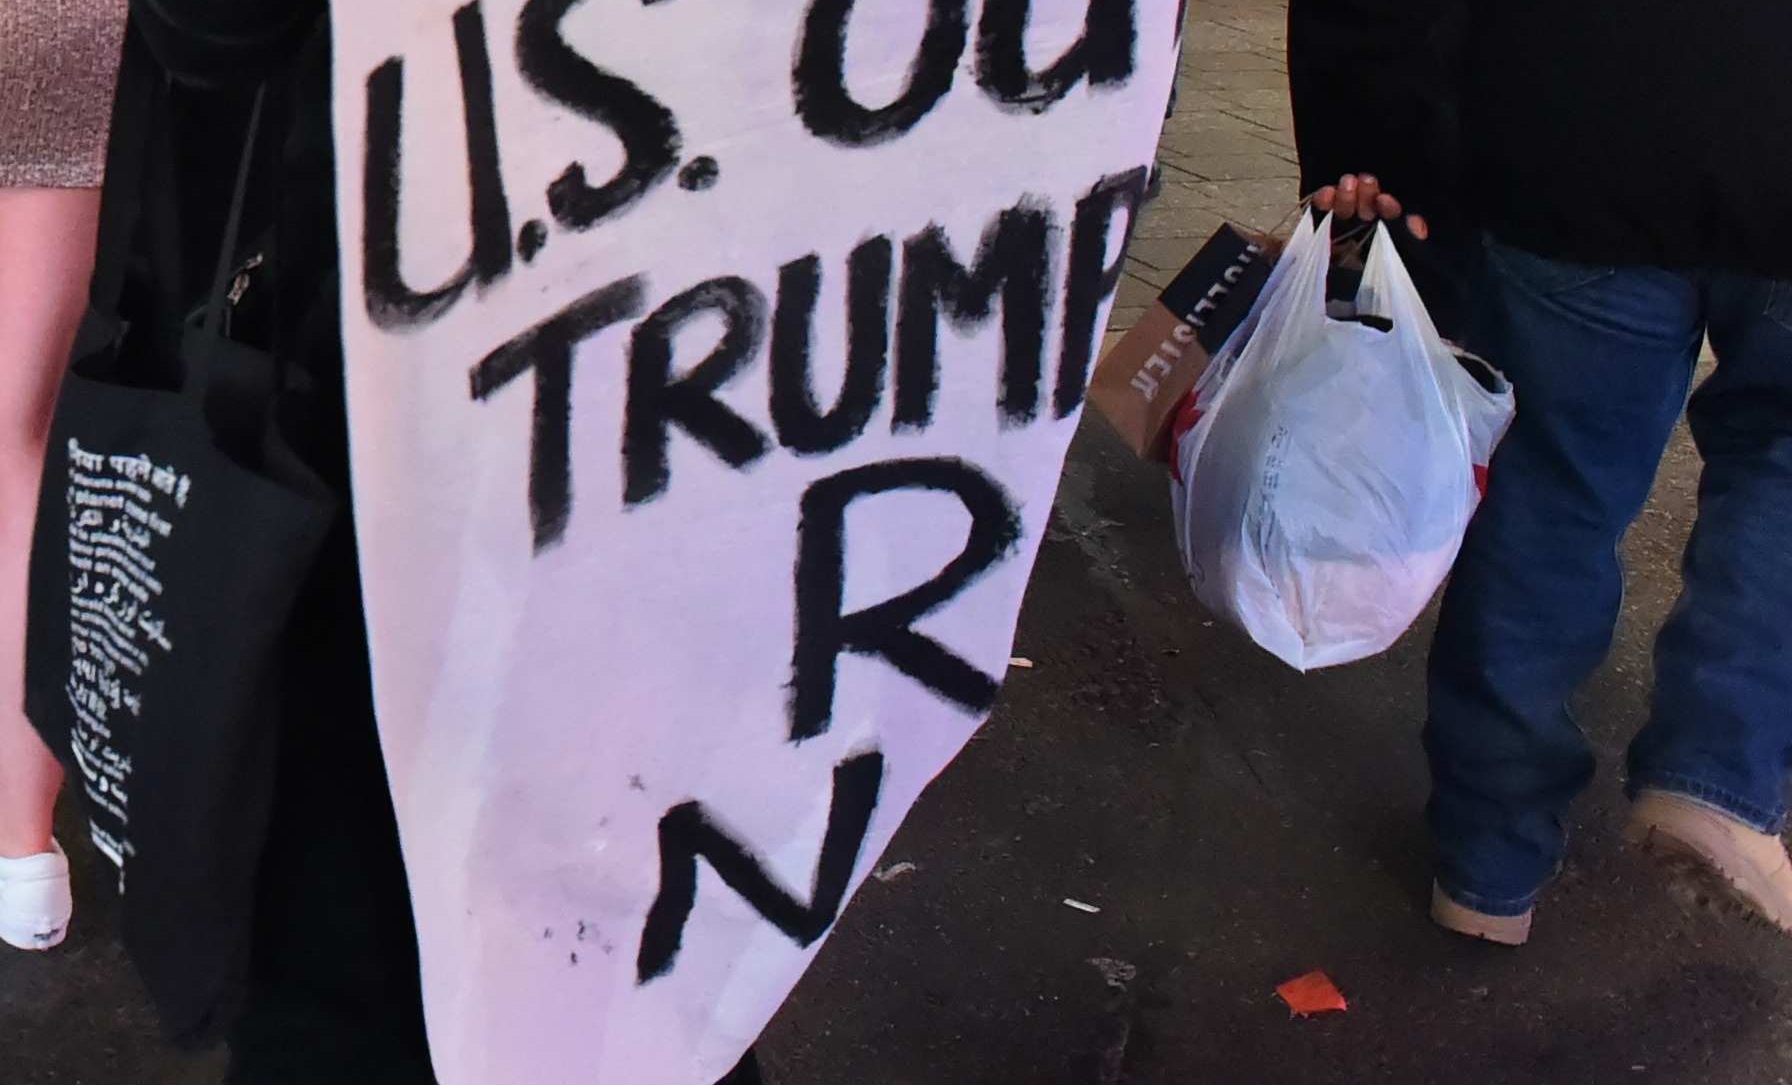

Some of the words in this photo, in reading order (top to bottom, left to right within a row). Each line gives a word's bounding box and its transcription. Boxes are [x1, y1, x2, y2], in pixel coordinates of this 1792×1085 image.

[470, 165, 1154, 558] TRUMP
[783, 456, 1024, 746] R
[637, 737, 885, 986] N
